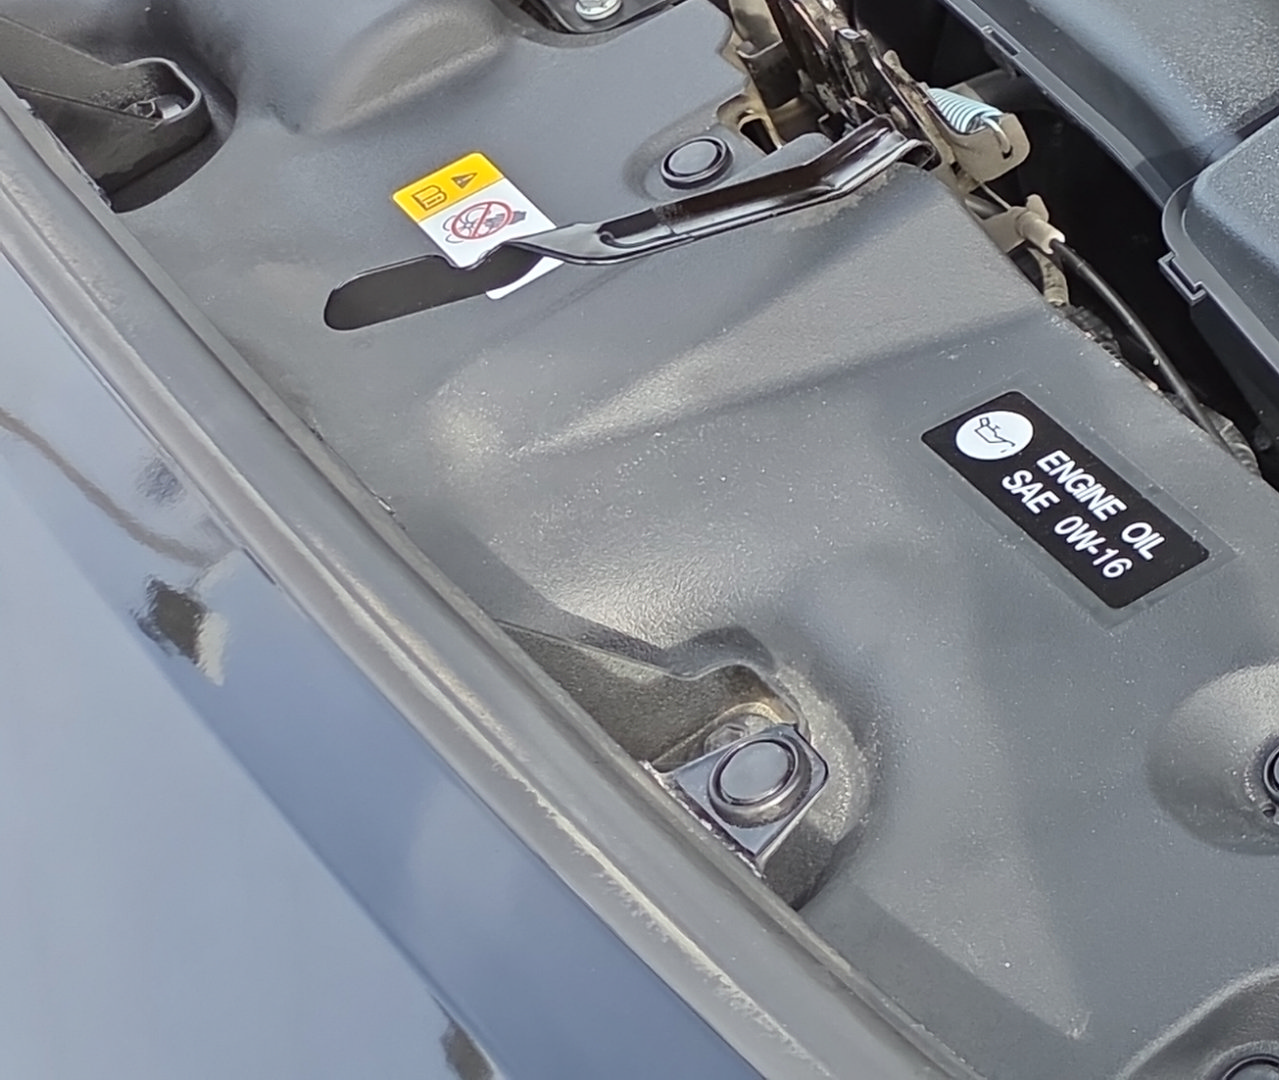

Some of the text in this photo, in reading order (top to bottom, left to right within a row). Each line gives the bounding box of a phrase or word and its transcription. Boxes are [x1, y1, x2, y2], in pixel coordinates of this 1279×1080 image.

[998, 465, 1135, 583] SAE 0W-16
[1035, 447, 1162, 562] ENGINE OIL
